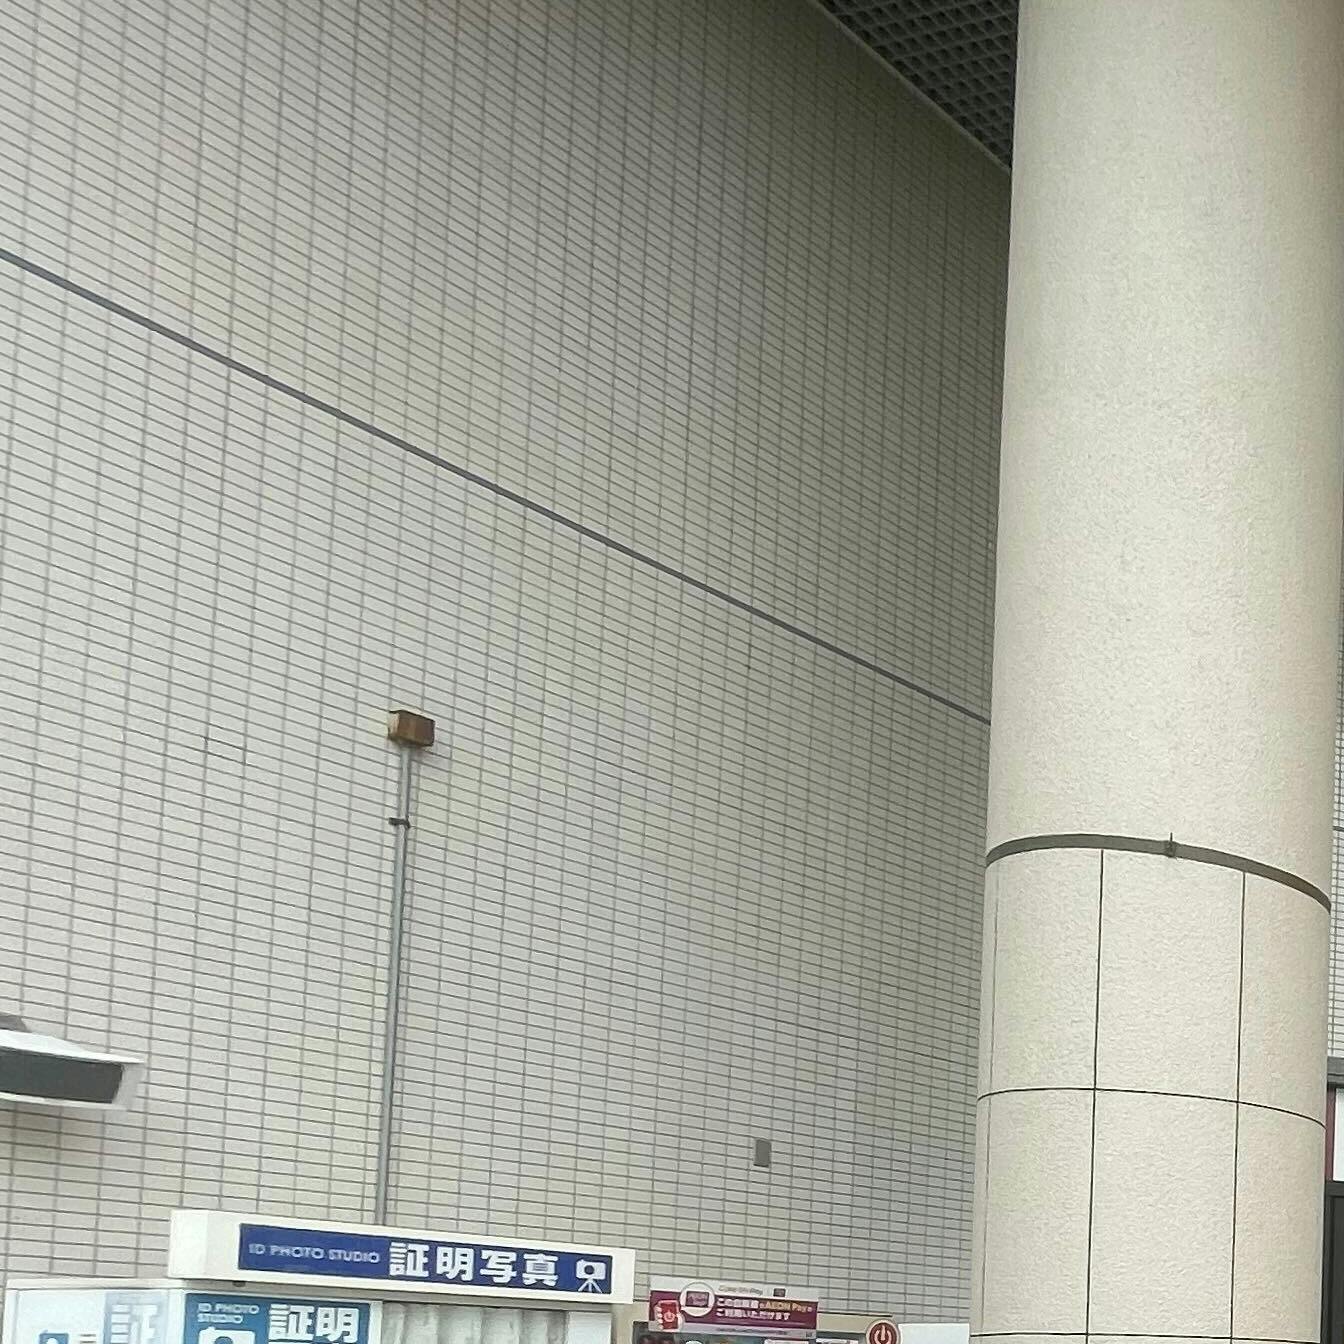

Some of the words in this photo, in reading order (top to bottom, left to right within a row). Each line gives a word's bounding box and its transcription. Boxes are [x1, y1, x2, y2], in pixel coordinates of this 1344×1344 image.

[248, 1244, 265, 1255] ID
[269, 1245, 324, 1261] PHOTO
[328, 1248, 380, 1264] STUDIO
[389, 1241, 559, 1286] 証明写真
[268, 1303, 361, 1343] 証明
